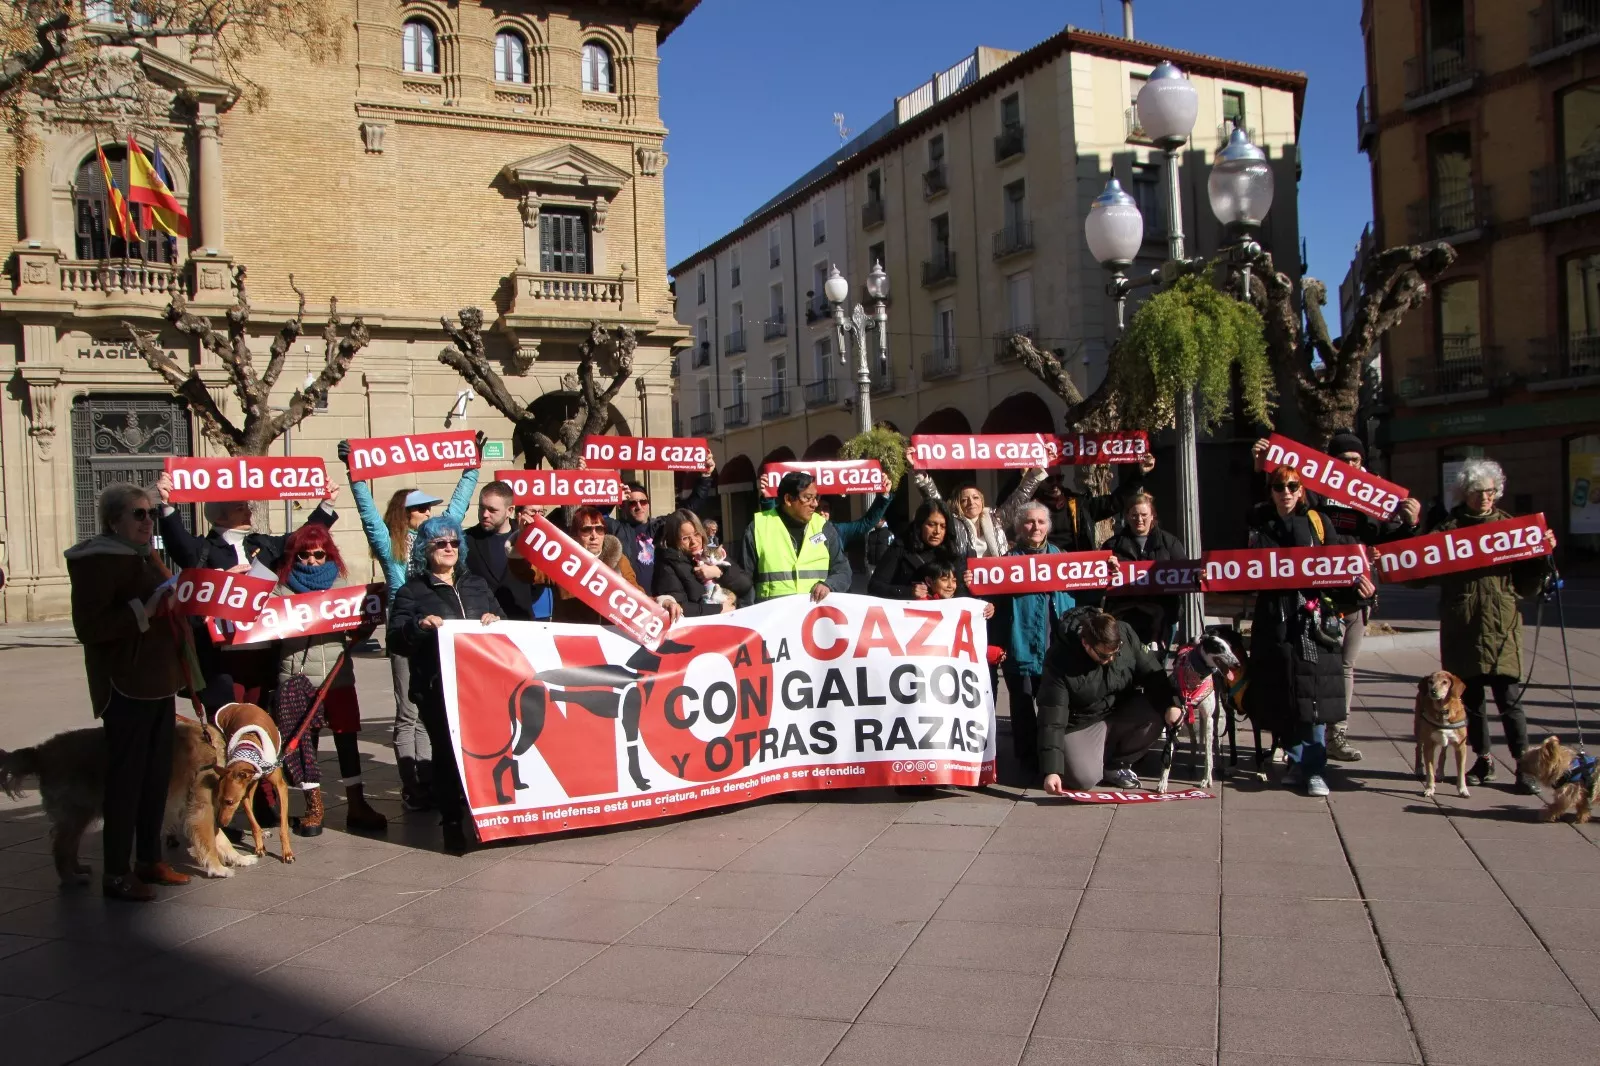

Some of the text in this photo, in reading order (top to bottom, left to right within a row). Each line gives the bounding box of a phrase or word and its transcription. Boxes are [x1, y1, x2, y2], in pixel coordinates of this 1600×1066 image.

[78, 349, 178, 359] HACIEA
[353, 447, 387, 470] no
[389, 445, 406, 463] a
[404, 437, 429, 462] la
[432, 439, 476, 460] caza
[585, 439, 707, 463] no a la caza
[916, 442, 947, 460] no
[951, 443, 964, 460] a
[969, 437, 990, 459] la
[995, 443, 1044, 459] caza
[1062, 441, 1074, 456] a
[1079, 434, 1097, 456] la
[1102, 438, 1146, 455] caza
[171, 460, 325, 490] no a la caza
[533, 479, 545, 496] a
[550, 473, 569, 495] la
[574, 479, 619, 496] caza
[768, 463, 882, 488] n la caza
[1266, 444, 1401, 513] no a la caza
[1380, 525, 1543, 573] no a la caza
[973, 557, 1108, 585] no a la caza
[1111, 570, 1124, 587] a
[1128, 563, 1150, 586] la
[1206, 551, 1364, 580] no a la caza
[195, 580, 215, 602] a
[217, 575, 249, 609] la
[524, 527, 664, 639] no a la caza
[261, 608, 279, 629] a
[284, 598, 313, 625] la
[319, 593, 382, 620] caza
[734, 643, 753, 669] A
[762, 637, 791, 665] LA
[801, 606, 979, 664] CAZA
[664, 663, 981, 730] CON GALGOS
[671, 716, 987, 779] Y OTRAS RAZAS
[475, 765, 866, 829] uanto más indefensa está una criatura, más derecho tiene a ser defendida
[1114, 792, 1144, 801] la
